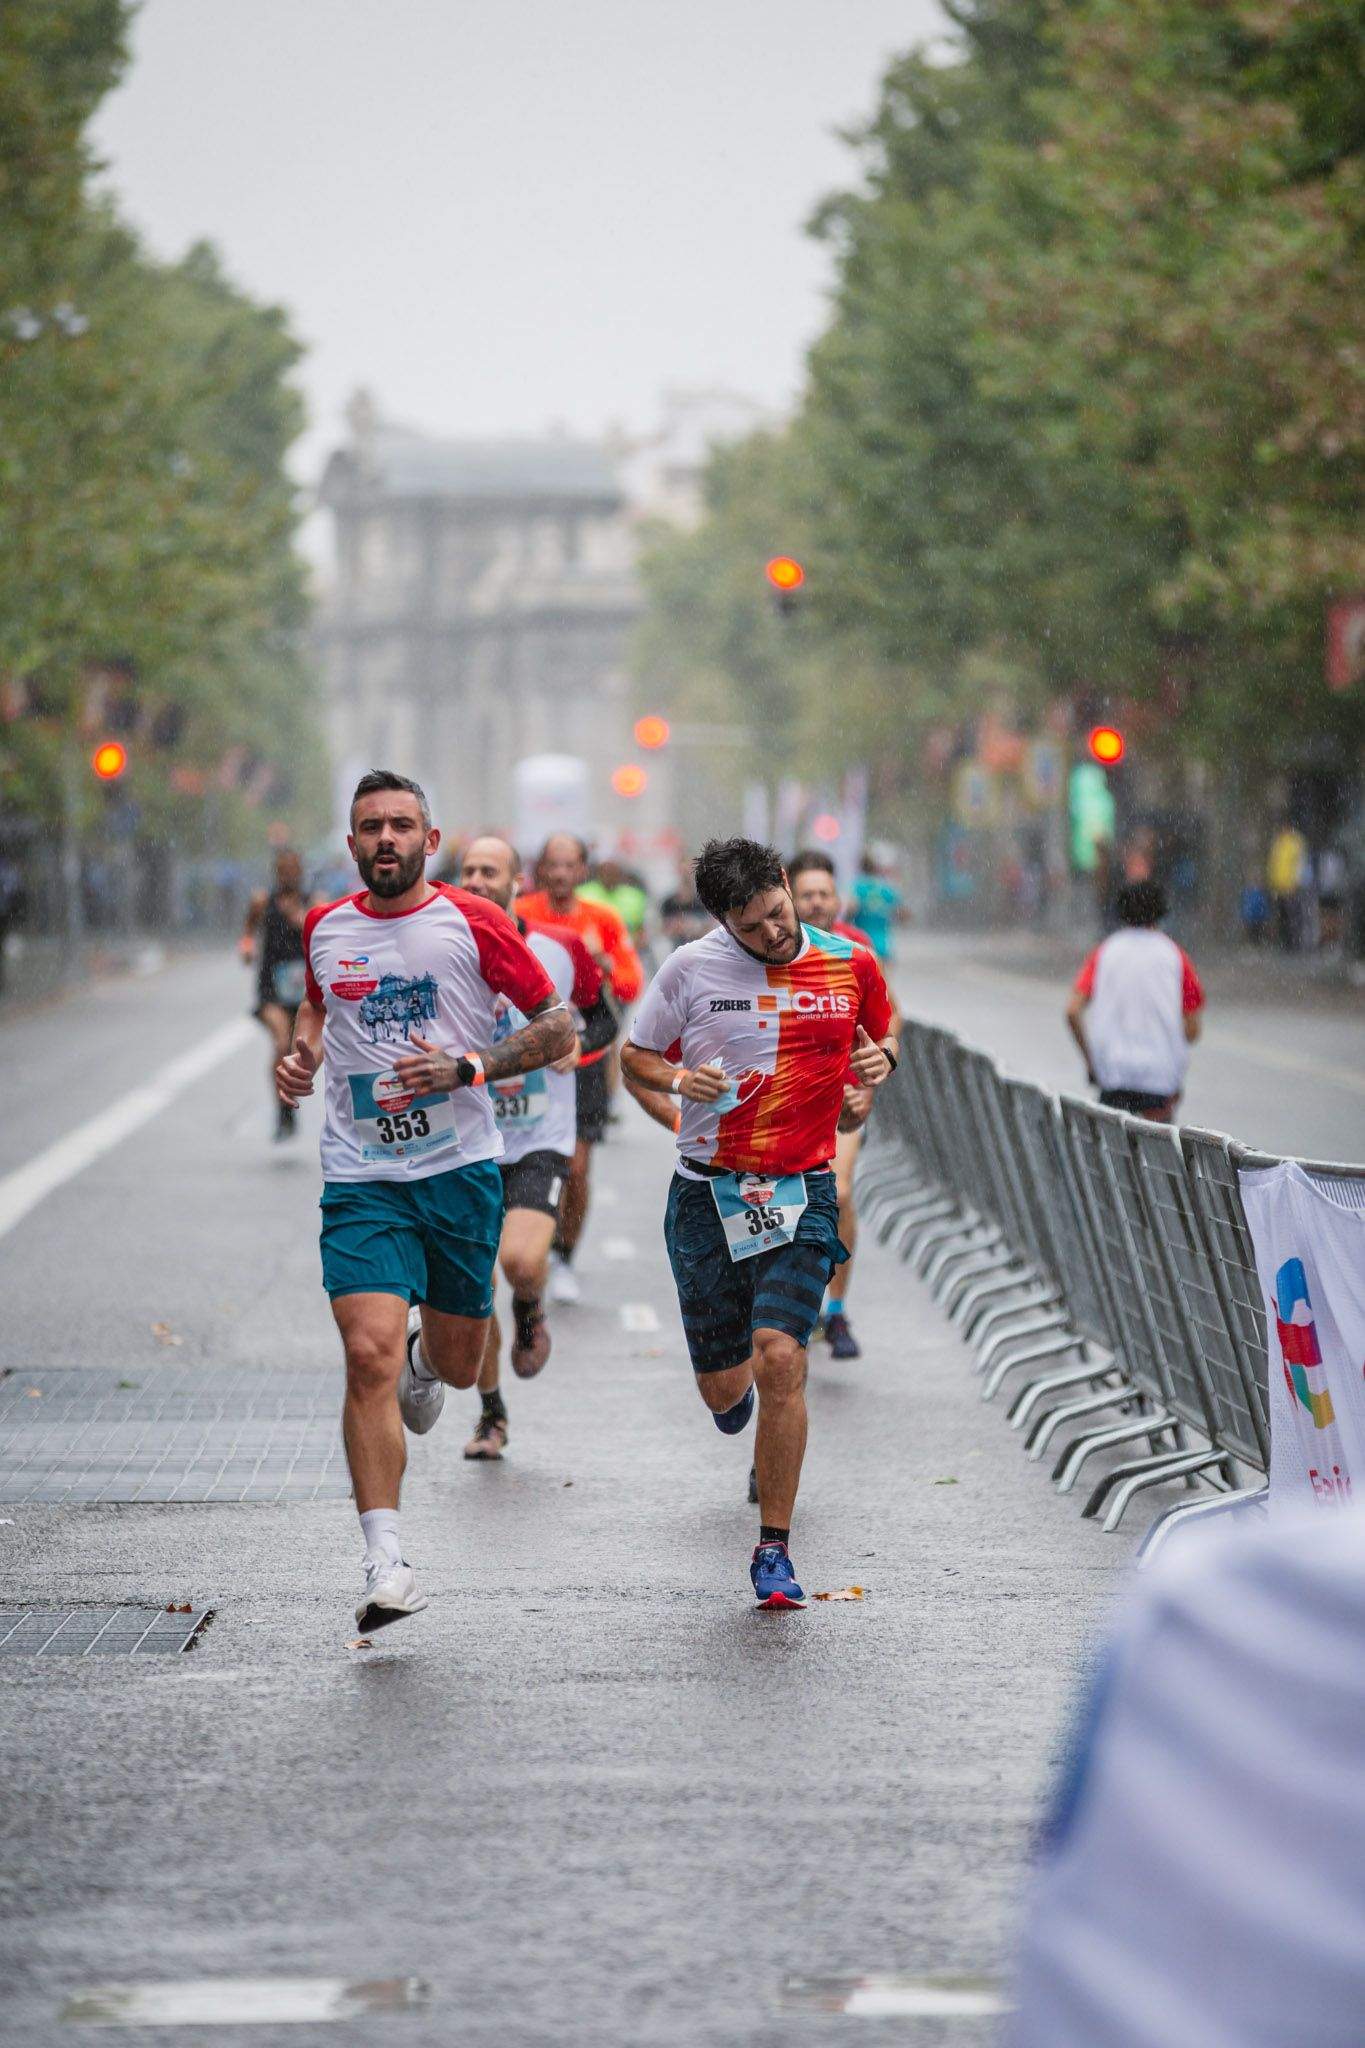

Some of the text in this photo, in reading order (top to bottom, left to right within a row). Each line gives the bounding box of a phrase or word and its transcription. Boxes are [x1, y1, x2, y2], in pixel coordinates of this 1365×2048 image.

[709, 999, 752, 1012] 226ERS
[792, 990, 851, 1013] Cris
[377, 1109, 430, 1144] 353
